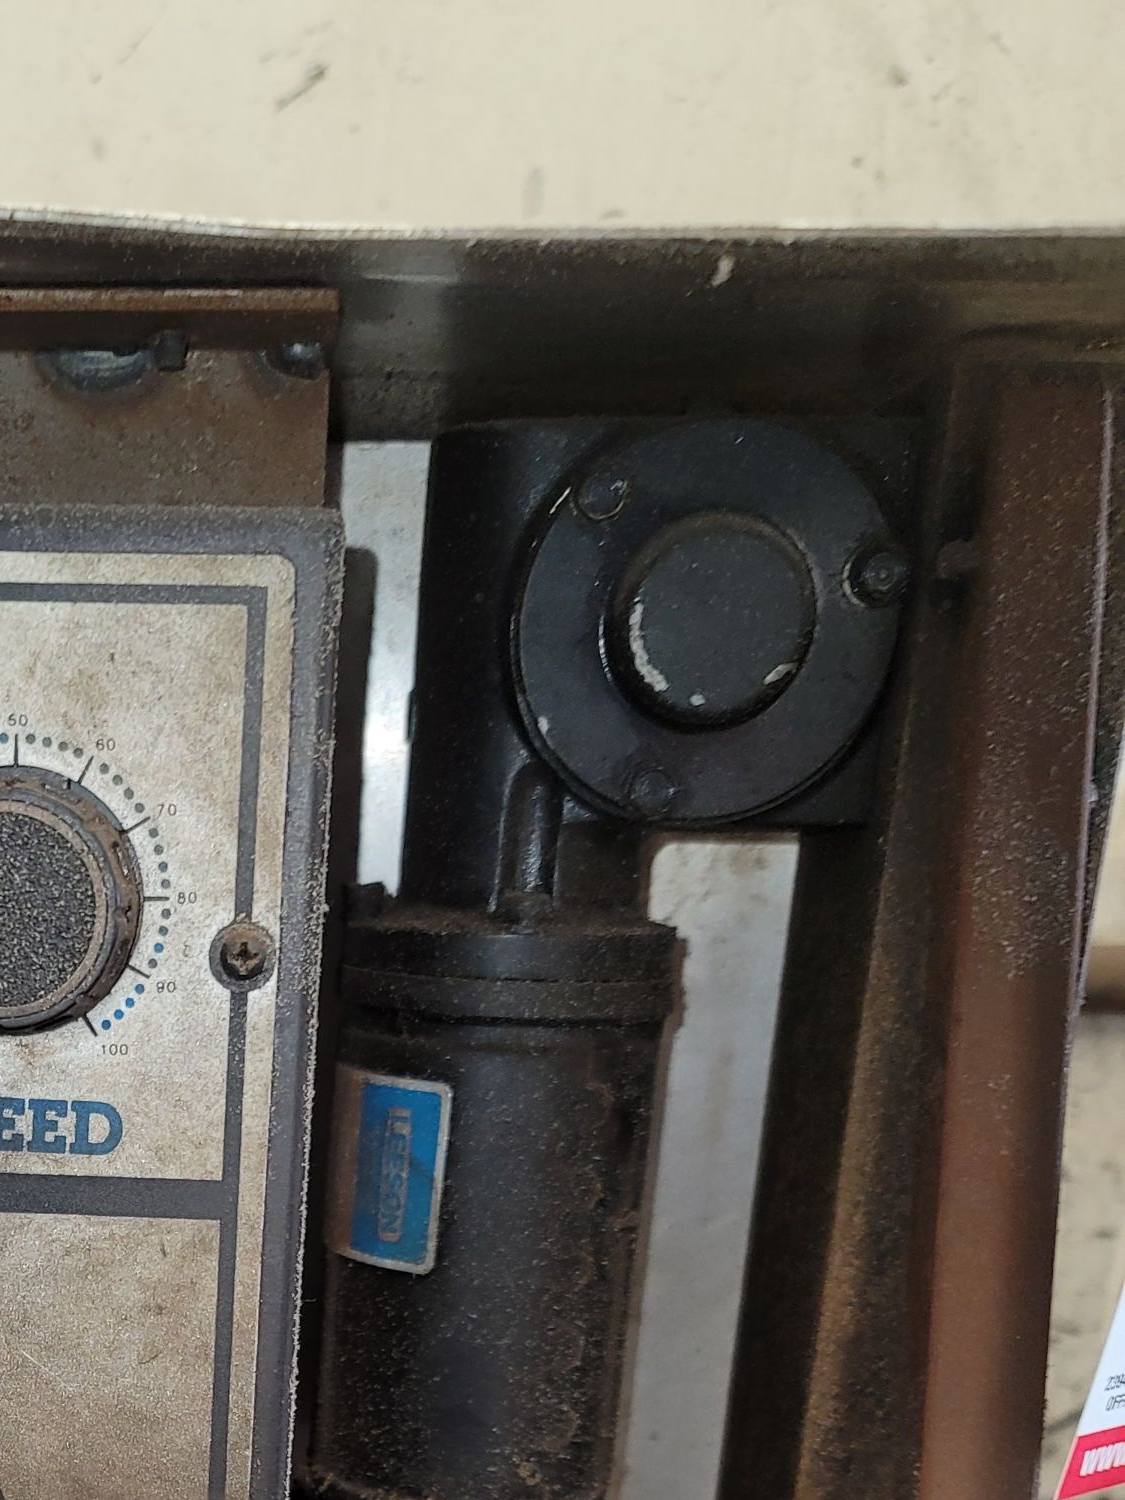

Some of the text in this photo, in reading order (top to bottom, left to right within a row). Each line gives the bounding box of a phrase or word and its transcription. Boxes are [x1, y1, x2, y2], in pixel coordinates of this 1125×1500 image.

[8, 714, 29, 727] 50
[95, 738, 116, 751] 60
[158, 804, 177, 817] 70
[178, 892, 197, 904] 80
[156, 981, 176, 994] 90
[101, 1044, 129, 1056] 100
